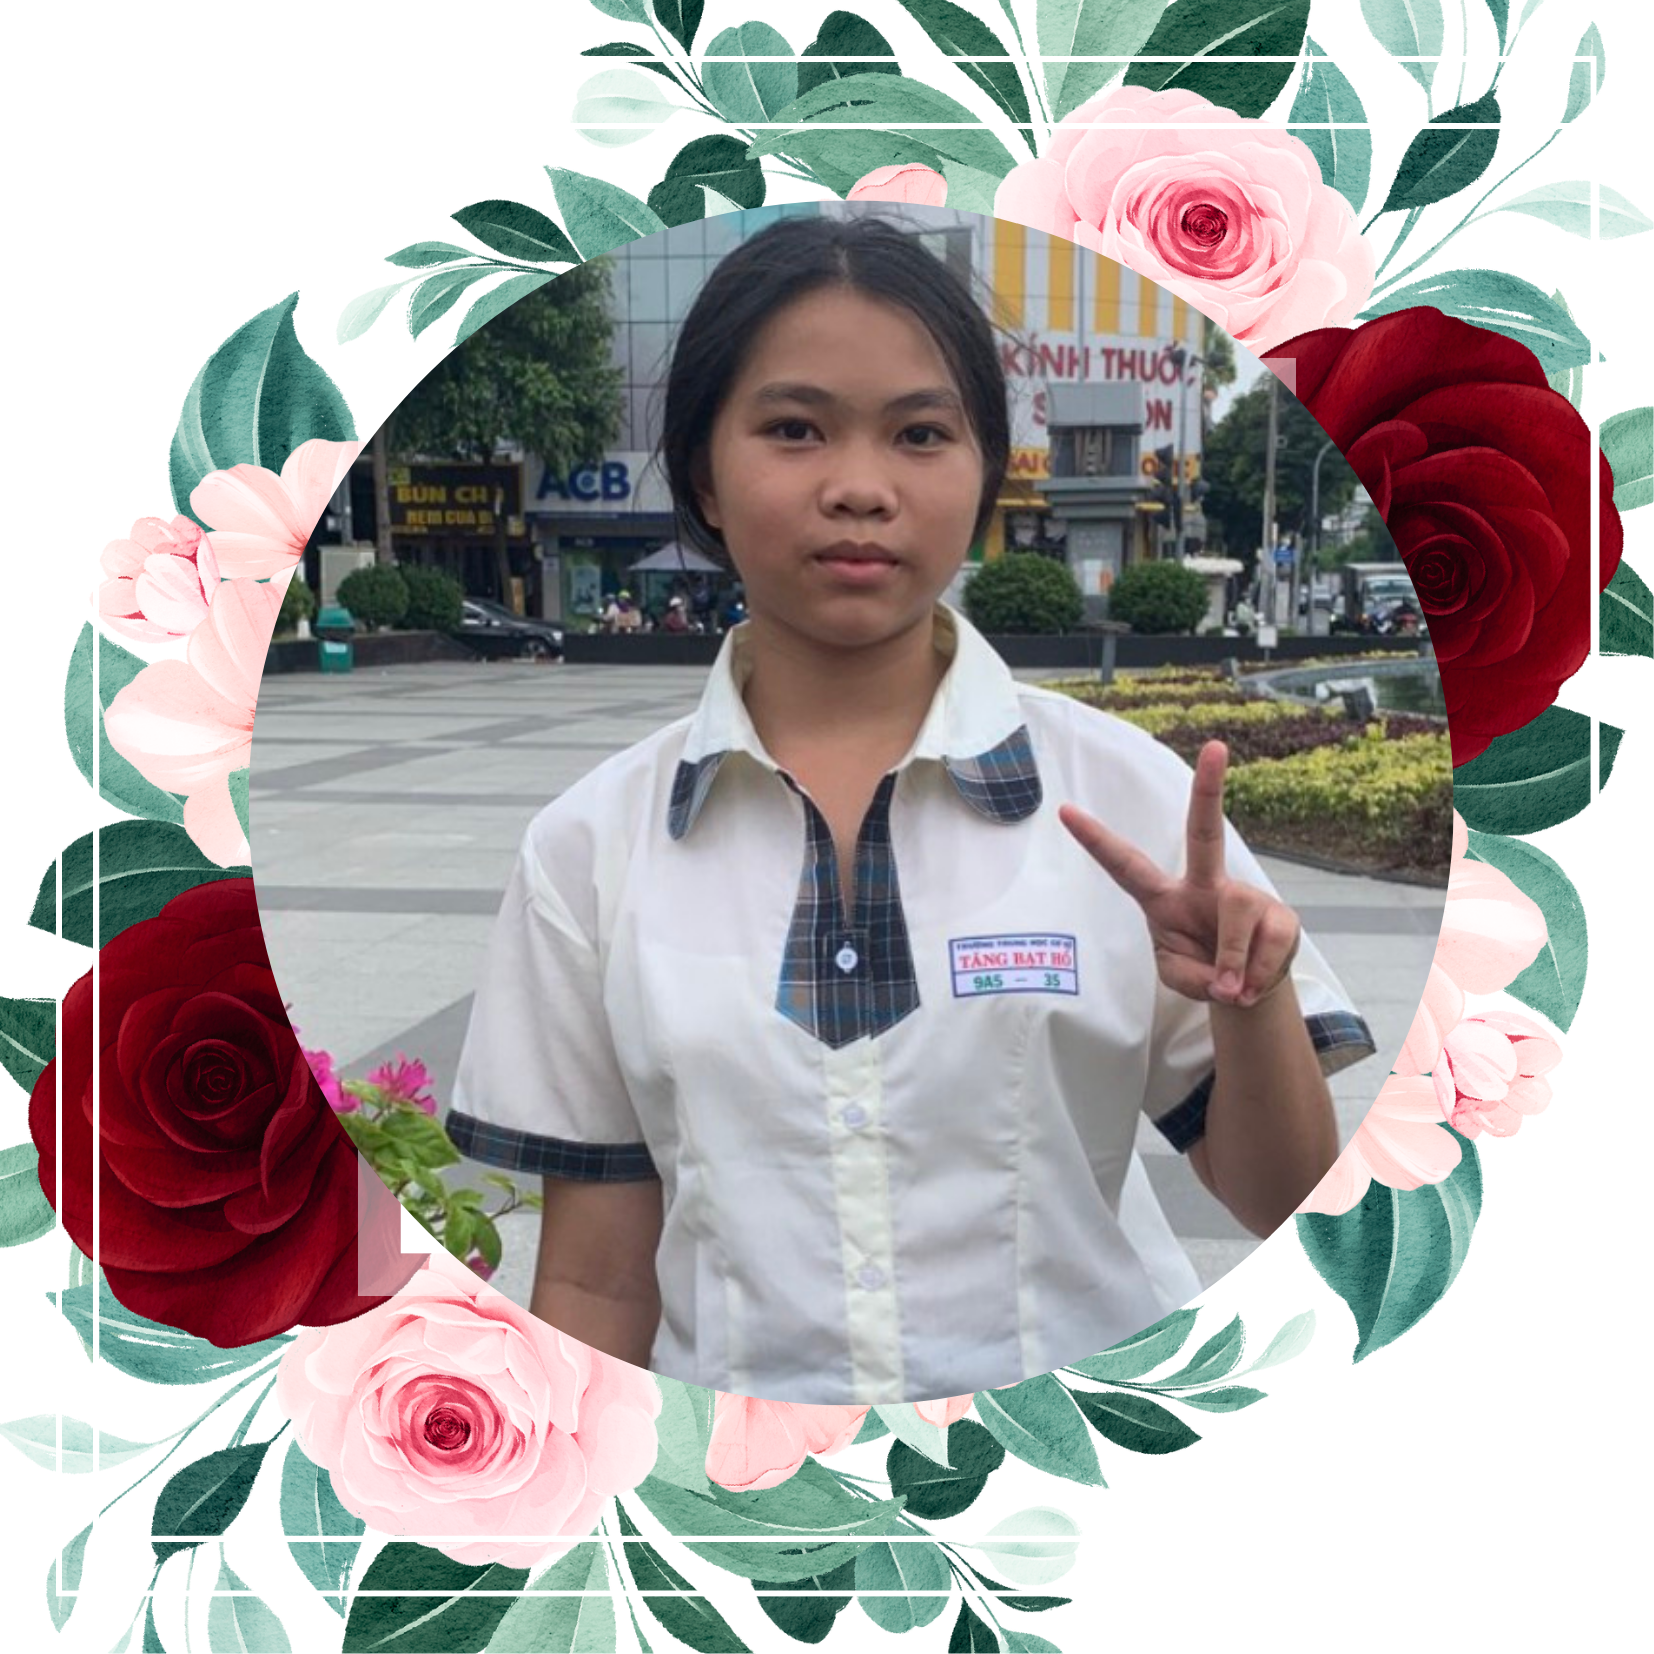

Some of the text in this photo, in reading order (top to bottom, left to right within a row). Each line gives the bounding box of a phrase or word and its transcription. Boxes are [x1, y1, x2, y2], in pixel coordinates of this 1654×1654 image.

[1002, 332, 1090, 379] KÍNH
[536, 461, 631, 501] ACB
[1013, 951, 1048, 969] BẠT
[973, 973, 1004, 990] 9A5
[1043, 972, 1061, 987] 35
